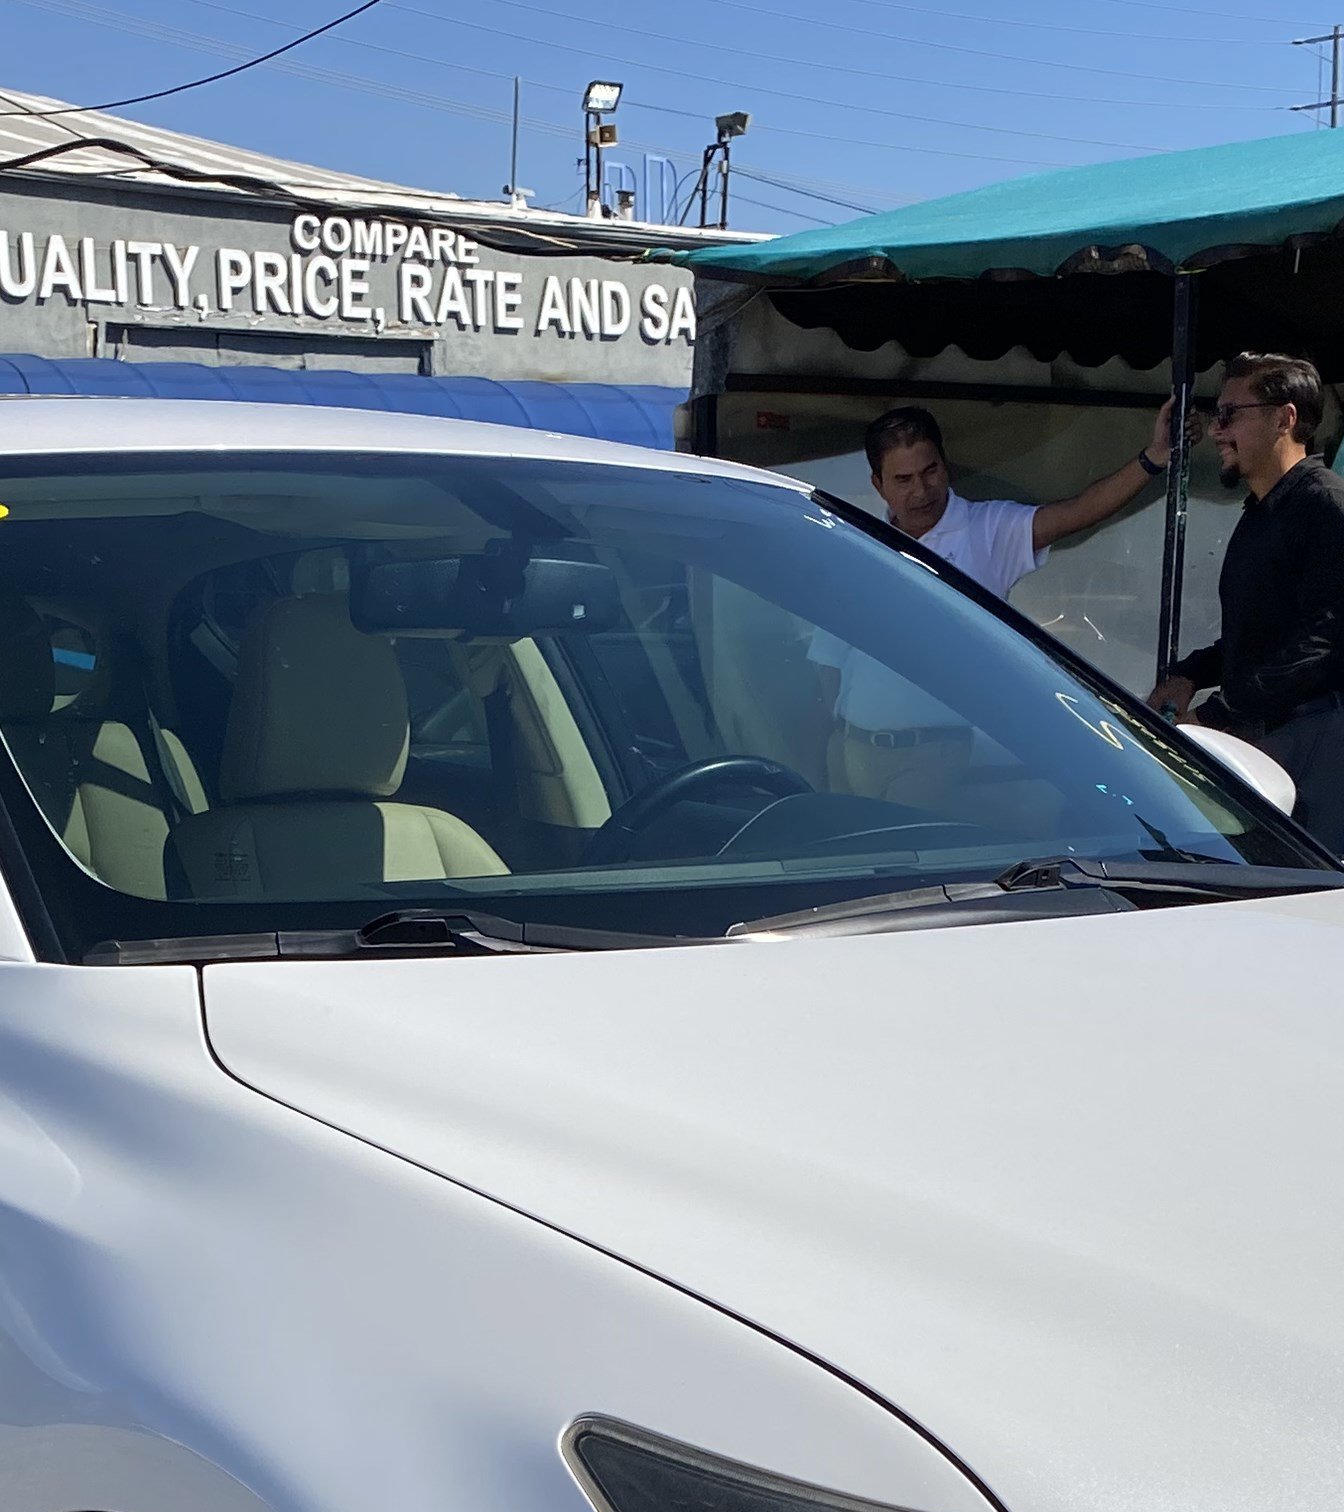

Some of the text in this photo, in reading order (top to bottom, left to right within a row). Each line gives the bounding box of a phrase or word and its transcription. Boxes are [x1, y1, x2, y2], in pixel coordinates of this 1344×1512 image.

[293, 214, 480, 264] COMPARE
[217, 247, 385, 333] PRICE,
[399, 263, 524, 329] RATE
[538, 275, 631, 335] AND
[642, 283, 696, 341] SA
